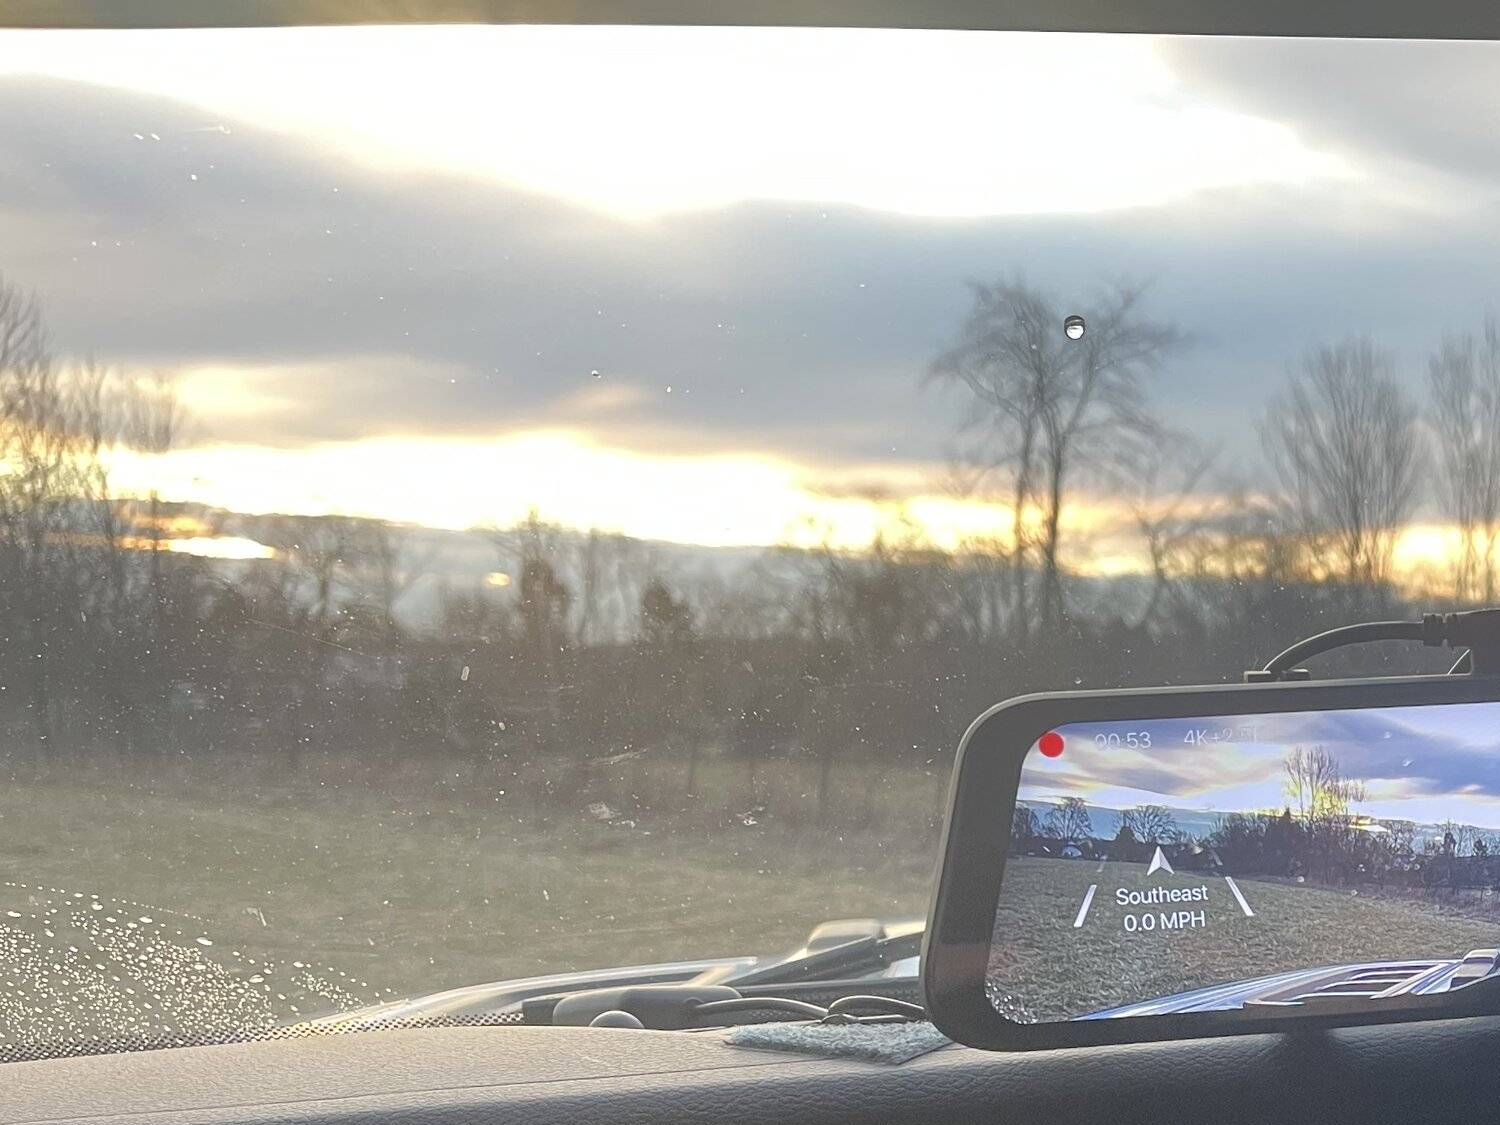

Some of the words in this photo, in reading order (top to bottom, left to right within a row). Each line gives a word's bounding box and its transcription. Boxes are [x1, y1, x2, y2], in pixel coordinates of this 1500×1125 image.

[1095, 731, 1152, 748] 00:53
[1116, 884, 1209, 906] Southeast
[1124, 912, 1155, 931] 0.0
[1160, 910, 1205, 929] MPH
